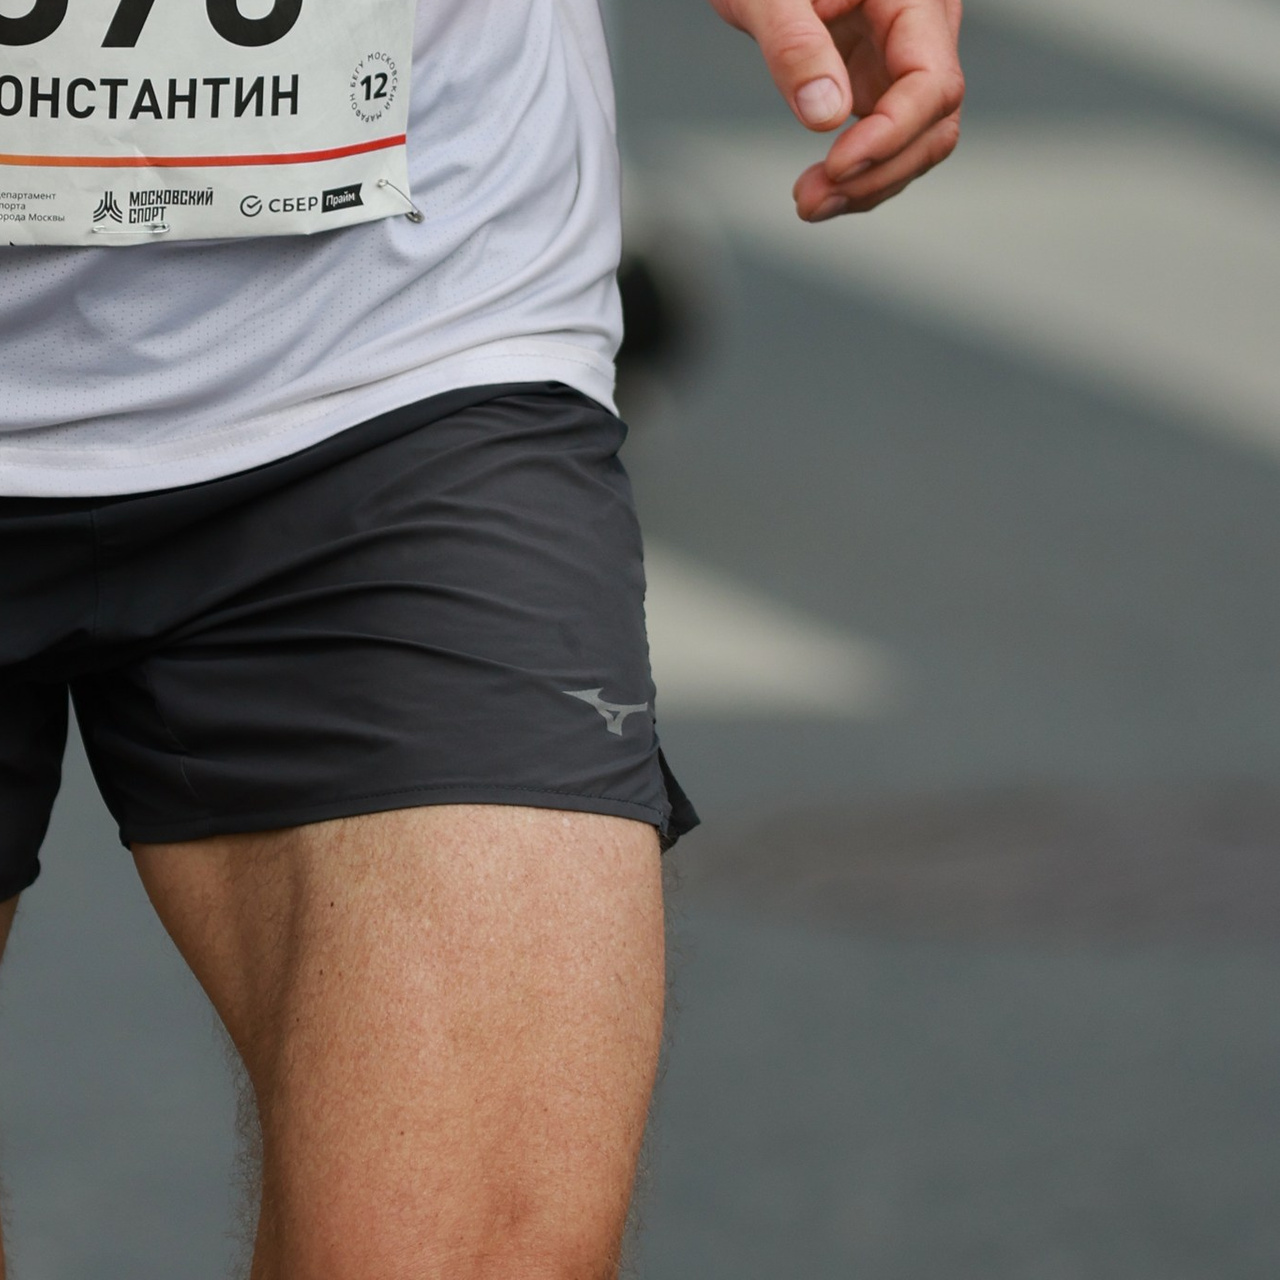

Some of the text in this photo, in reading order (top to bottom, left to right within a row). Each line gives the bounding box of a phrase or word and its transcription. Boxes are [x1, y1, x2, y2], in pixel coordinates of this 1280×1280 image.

[359, 72, 389, 102] 12
[128, 187, 214, 207] МОСКОВСКИЙ
[268, 190, 357, 214] СБЕР Прайм
[27, 213, 66, 222] Москвы
[128, 206, 167, 224] СПОРТ
